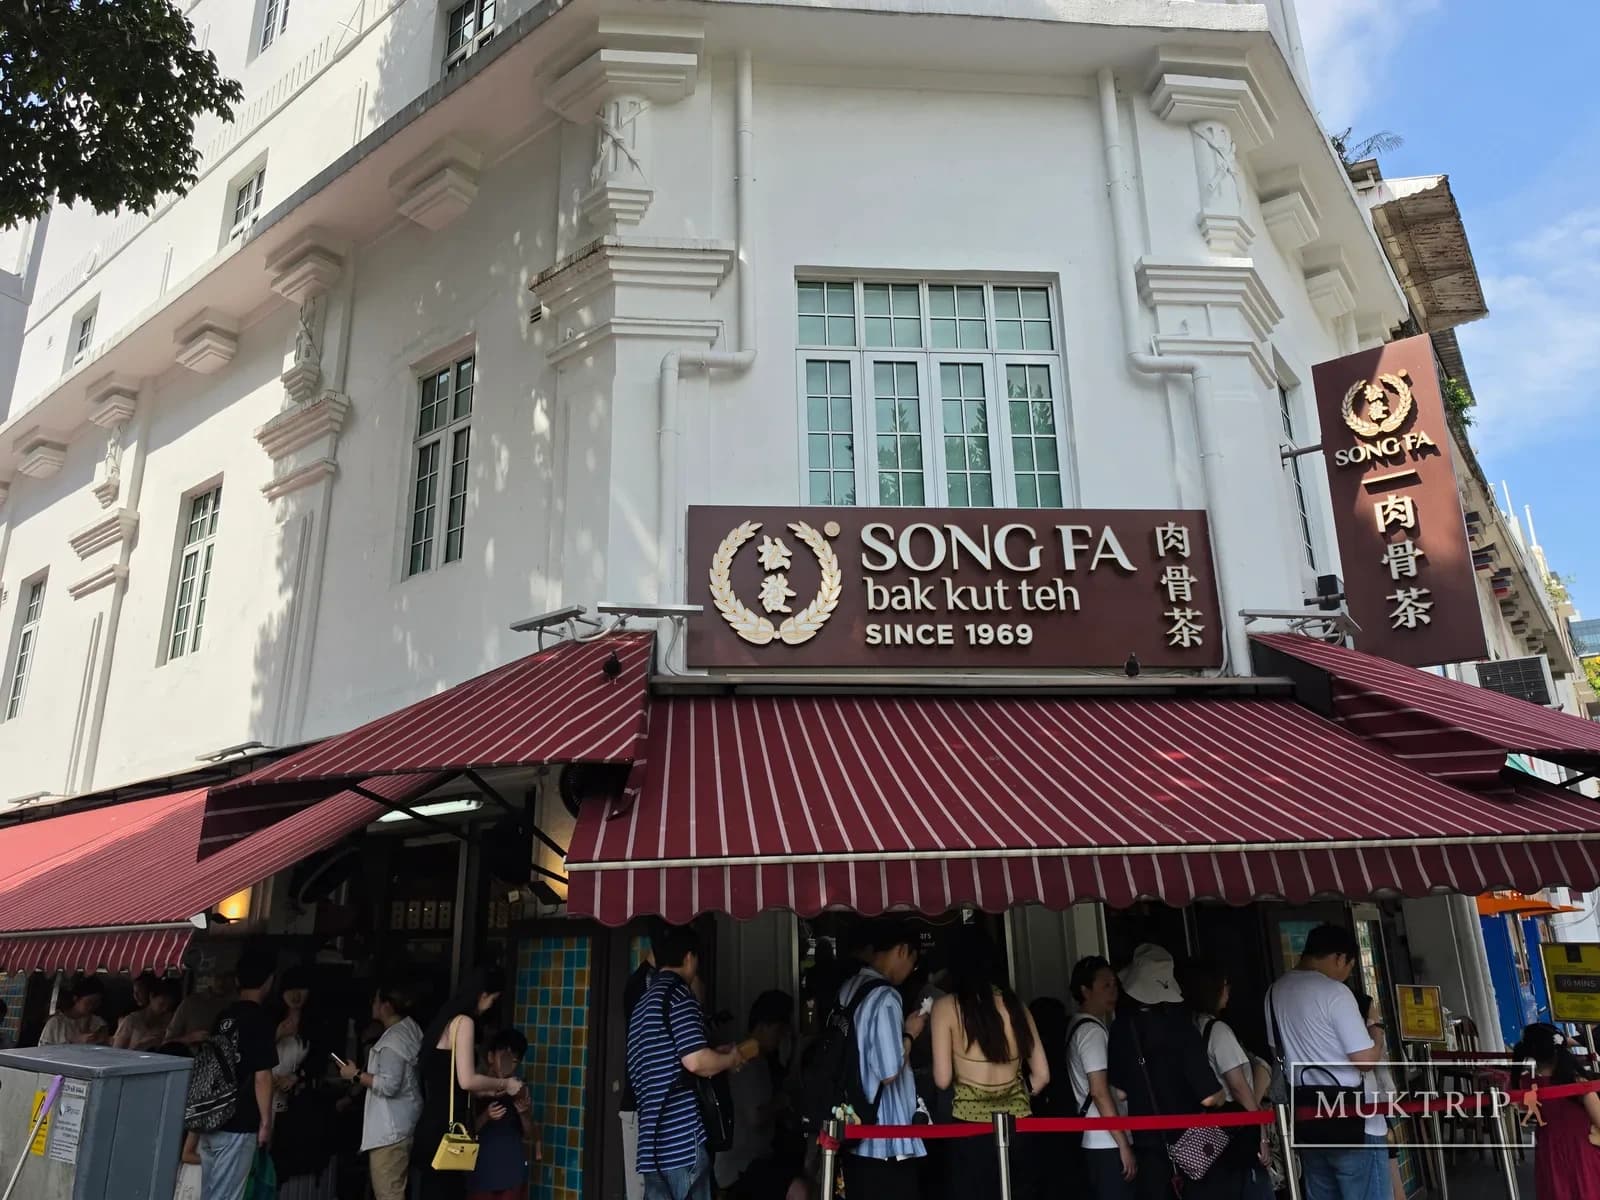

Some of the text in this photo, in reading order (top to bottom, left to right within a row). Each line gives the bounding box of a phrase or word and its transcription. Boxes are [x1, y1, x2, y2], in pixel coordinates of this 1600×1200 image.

[1335, 430, 1435, 466] SONG FA
[860, 522, 1138, 573] SONG FA
[1374, 494, 1434, 630] 肉骨茶
[864, 576, 1080, 612] bak kut teh
[1155, 520, 1204, 648] 肉骨茶
[866, 623, 1033, 646] SINCE 1969
